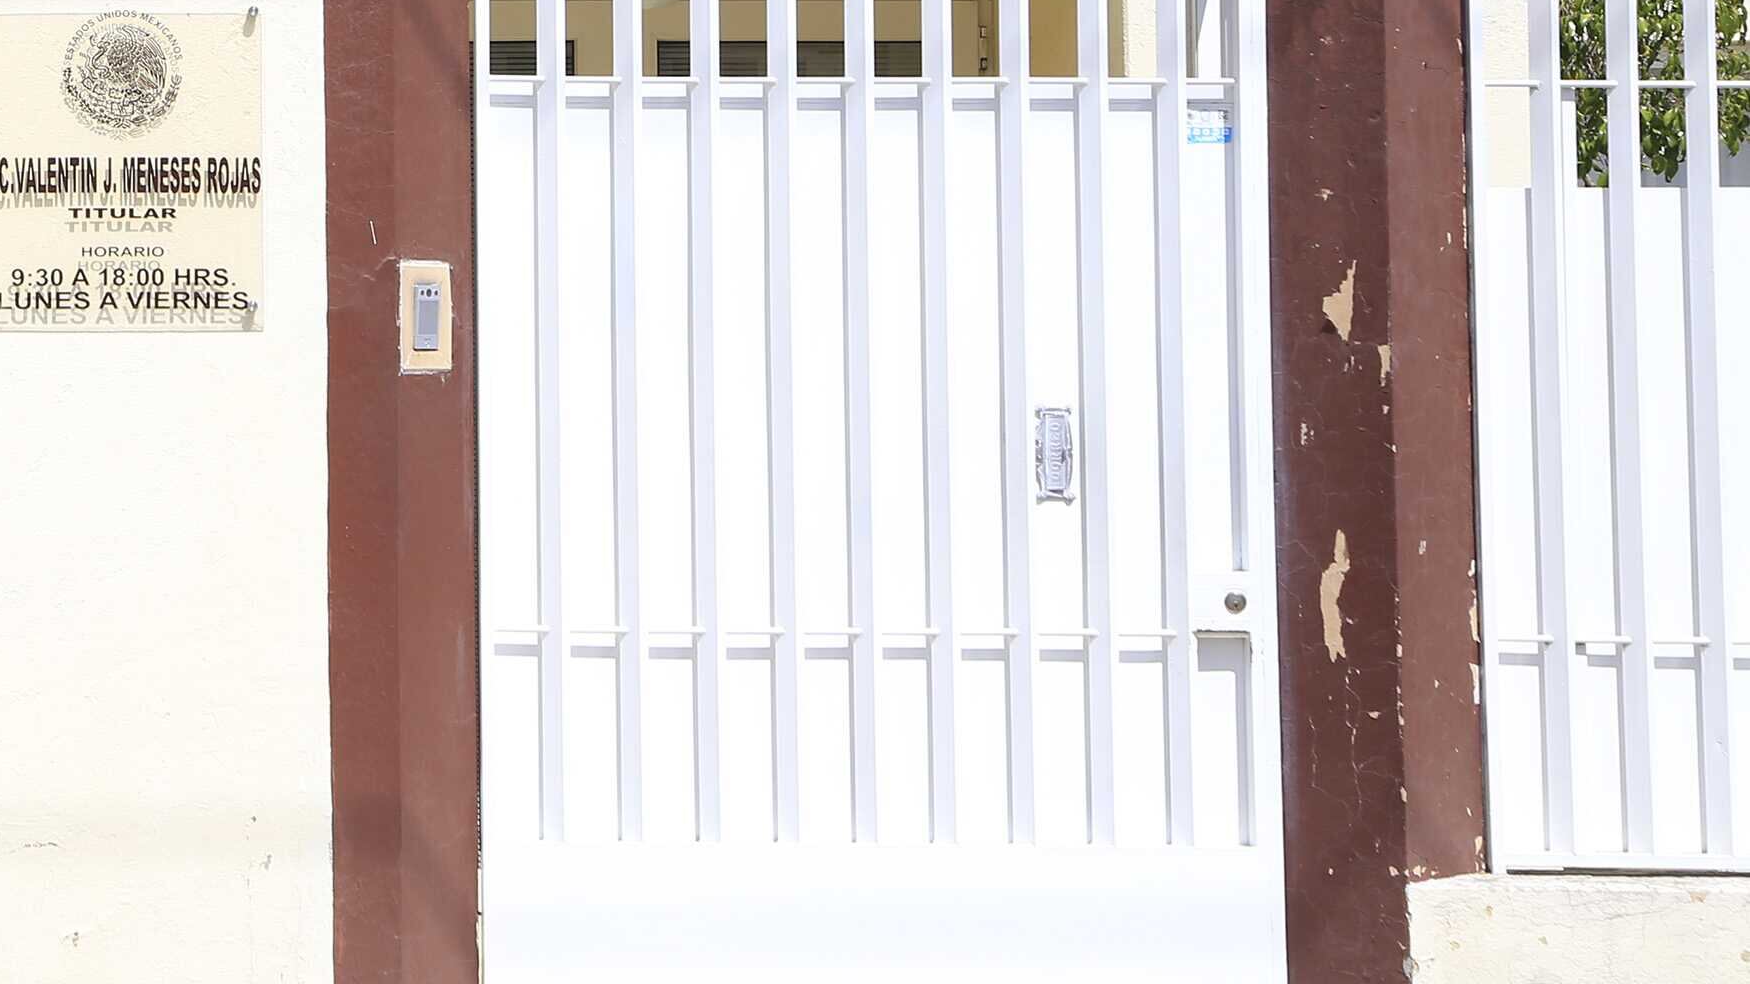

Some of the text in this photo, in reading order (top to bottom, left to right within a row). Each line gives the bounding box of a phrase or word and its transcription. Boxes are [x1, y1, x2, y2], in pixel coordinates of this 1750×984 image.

[64, 9, 183, 62] ESTADOS UNIDOS MEXICANOS
[103, 156, 117, 194] J.
[122, 156, 201, 194] MENESES
[207, 156, 262, 194] ROJAS
[68, 207, 177, 219] TITULAR
[81, 246, 165, 258] HORARIO
[11, 268, 237, 287] 9:30 A 18:00 HRS.
[99, 291, 119, 309] A
[126, 291, 249, 311] VIERNES
